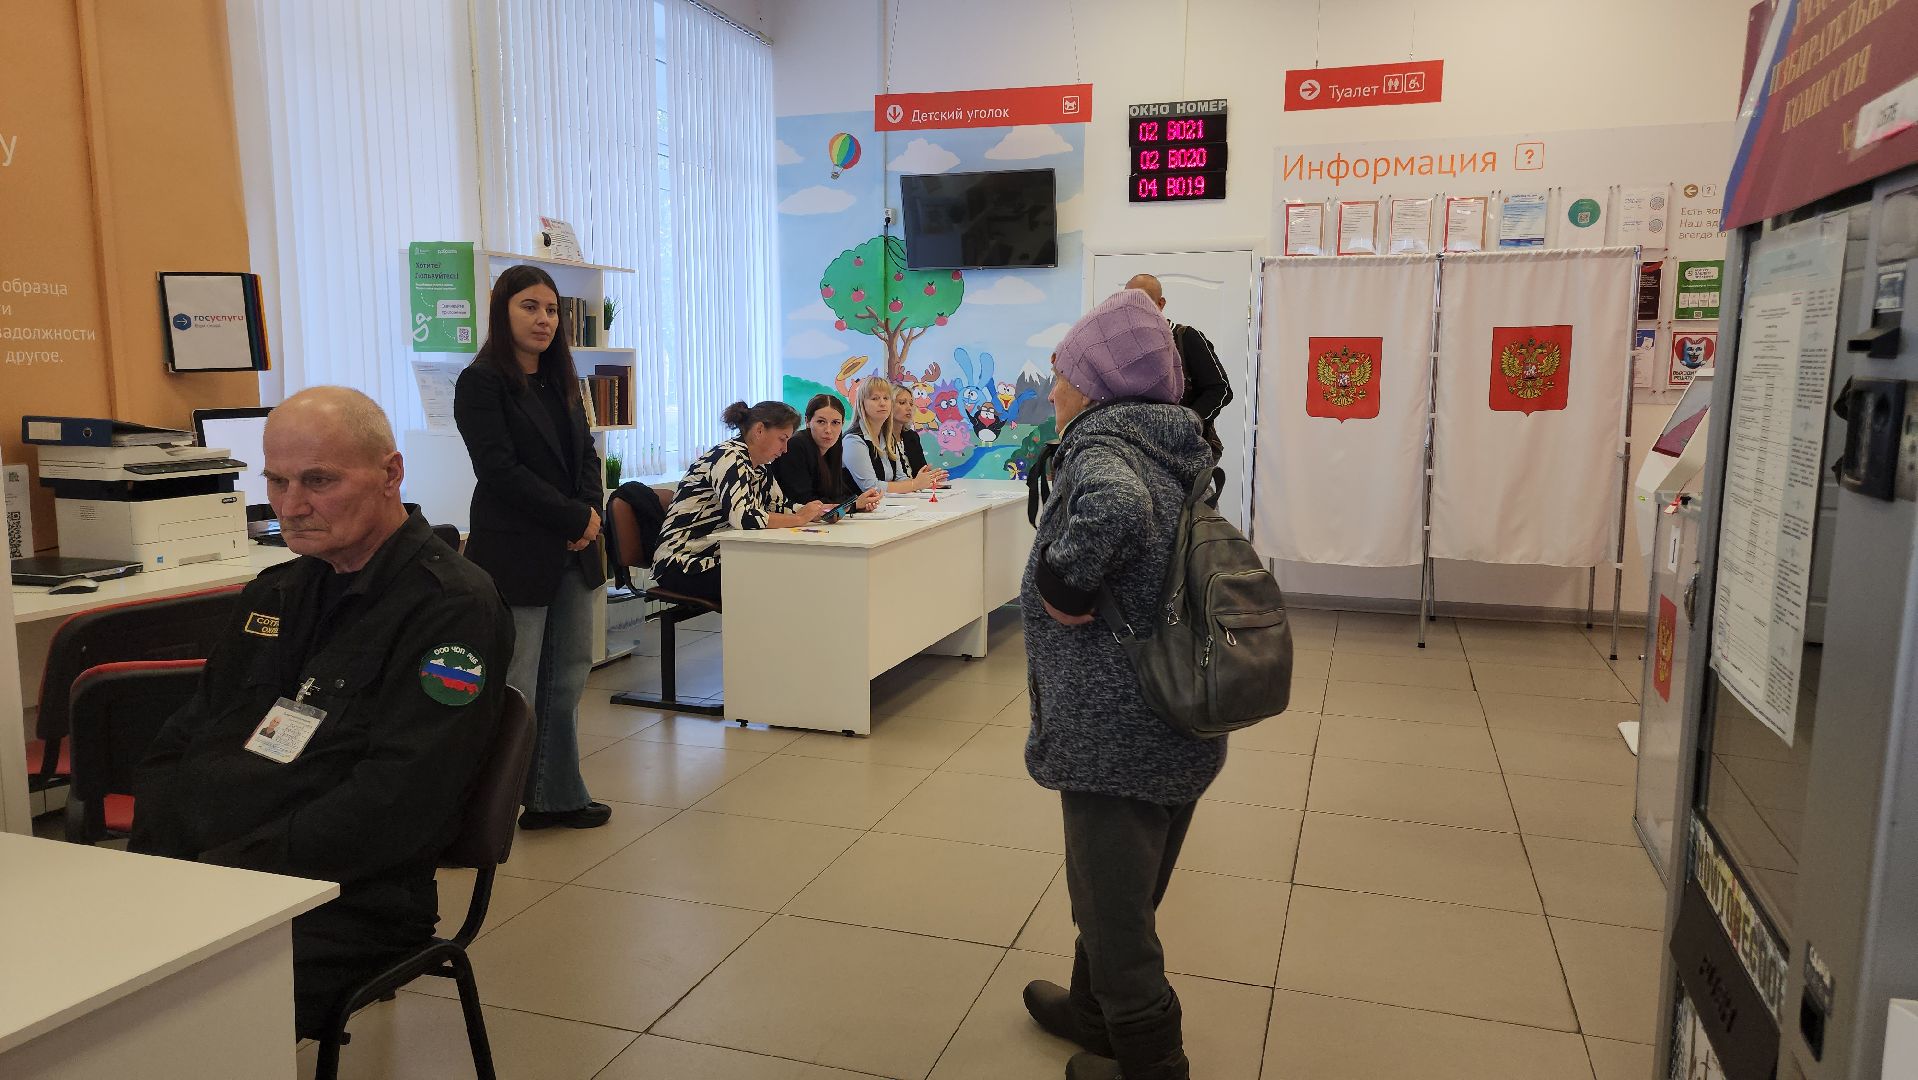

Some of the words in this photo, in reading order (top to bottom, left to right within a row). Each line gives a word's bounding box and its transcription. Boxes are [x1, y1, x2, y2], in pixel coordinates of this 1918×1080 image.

[1328, 84, 1380, 102] Туалет
[1781, 43, 1872, 134] КОМИССИЯ
[911, 108, 963, 124] Детский
[967, 108, 1010, 122] уголок
[1129, 104, 1170, 117] ОКНО
[1176, 100, 1227, 114] НОМЕР
[1139, 122, 1158, 142] 02
[1140, 150, 1160, 169] 02
[1283, 151, 1497, 186] Информация
[1138, 178, 1158, 198] 04
[2, 278, 67, 296] образца
[194, 315, 244, 323] госуслуги
[5, 348, 64, 366] другое.
[434, 646, 450, 656] ООО
